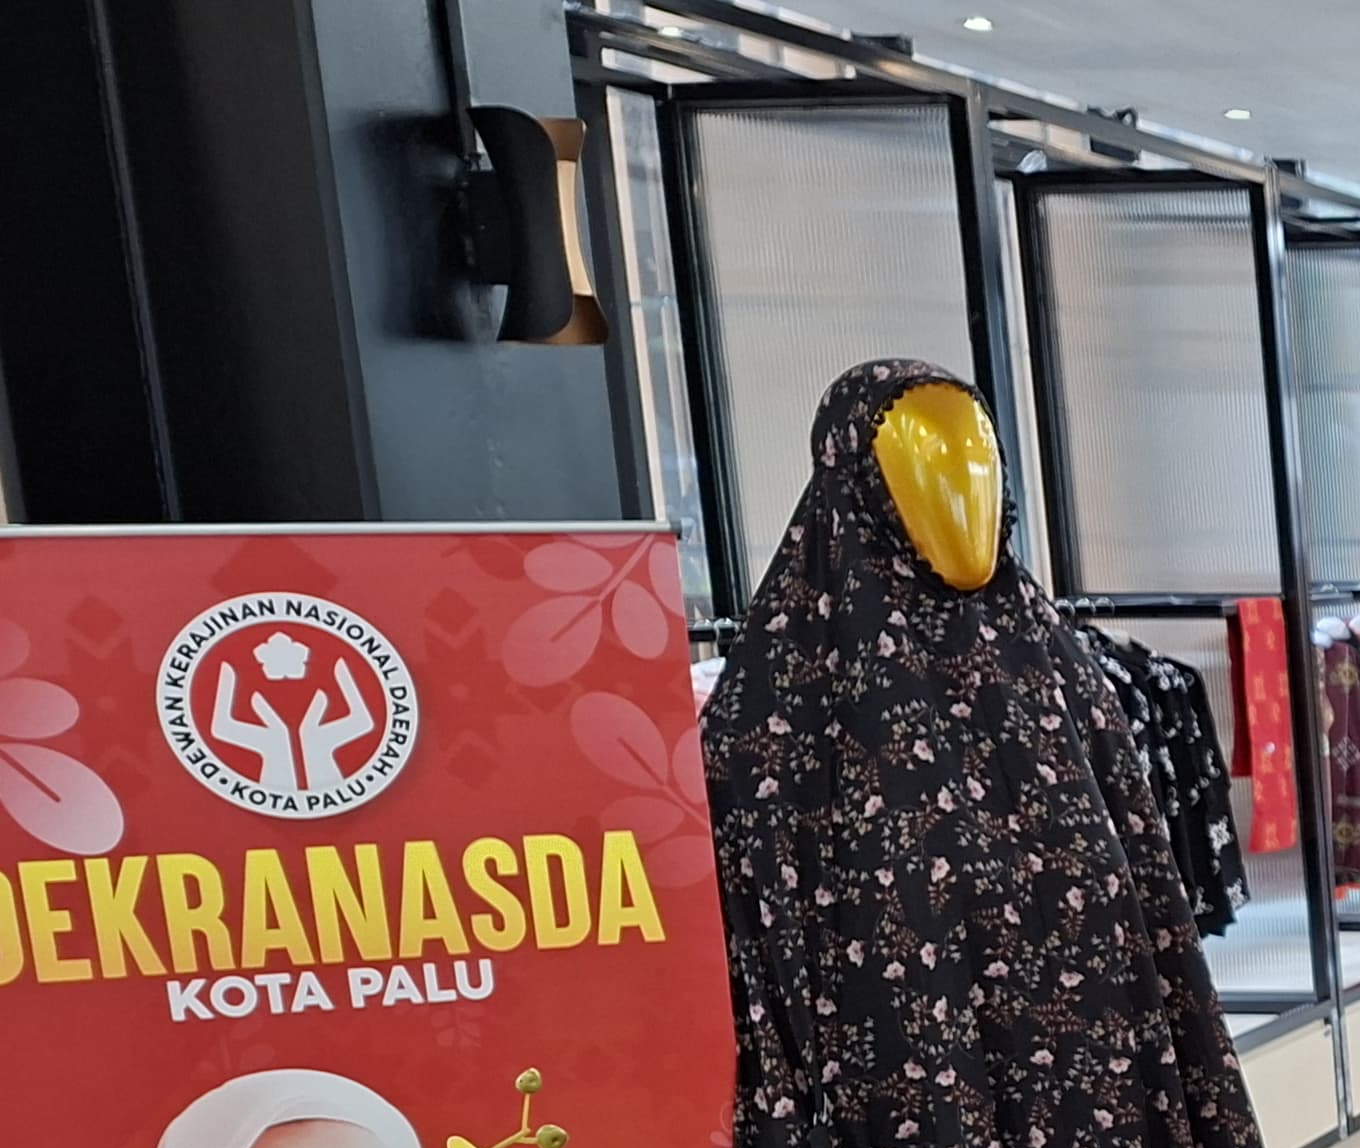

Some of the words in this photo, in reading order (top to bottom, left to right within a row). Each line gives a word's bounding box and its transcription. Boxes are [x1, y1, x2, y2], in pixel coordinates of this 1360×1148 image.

[164, 598, 276, 690] KERAJINAN
[285, 599, 400, 680] NASIONAL
[164, 695, 221, 780] DEWAN
[372, 685, 411, 777] DAERAH
[229, 781, 299, 812] KOTA
[306, 778, 367, 812] PALU
[166, 971, 334, 1022] KOTA
[348, 958, 494, 1008] PALU
